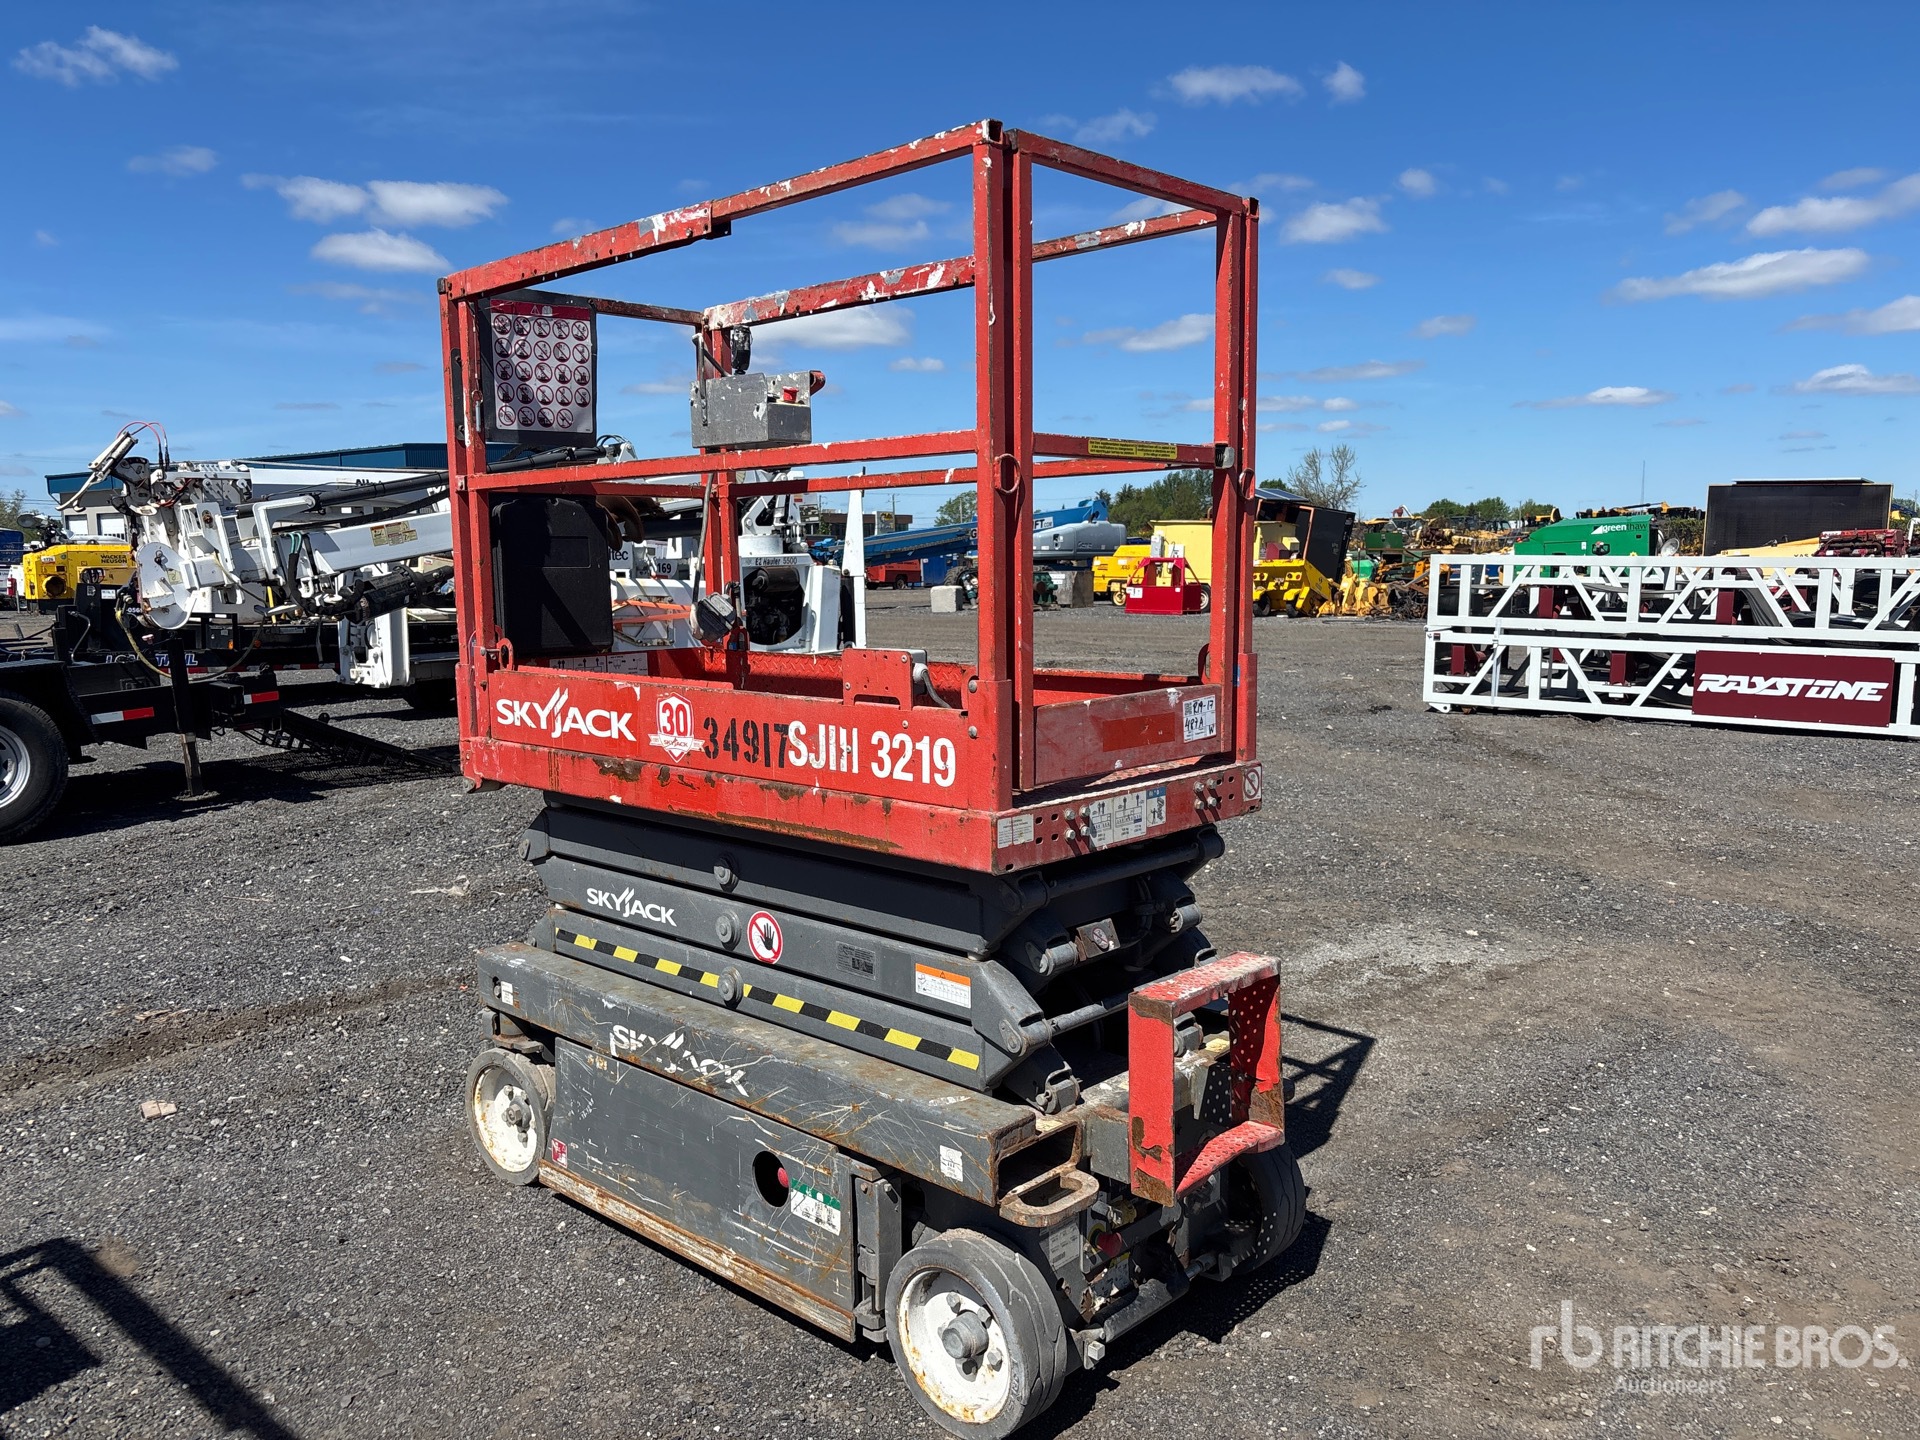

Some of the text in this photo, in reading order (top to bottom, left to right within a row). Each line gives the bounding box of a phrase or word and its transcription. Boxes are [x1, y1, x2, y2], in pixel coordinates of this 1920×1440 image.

[783, 556, 798, 565] 5500
[1697, 673, 1889, 702] RAYSTONE
[496, 687, 637, 742] SKYJACK
[662, 702, 688, 737] 30
[703, 717, 789, 768] 34917
[870, 731, 957, 787] 3219
[586, 887, 678, 927] SKYJACK
